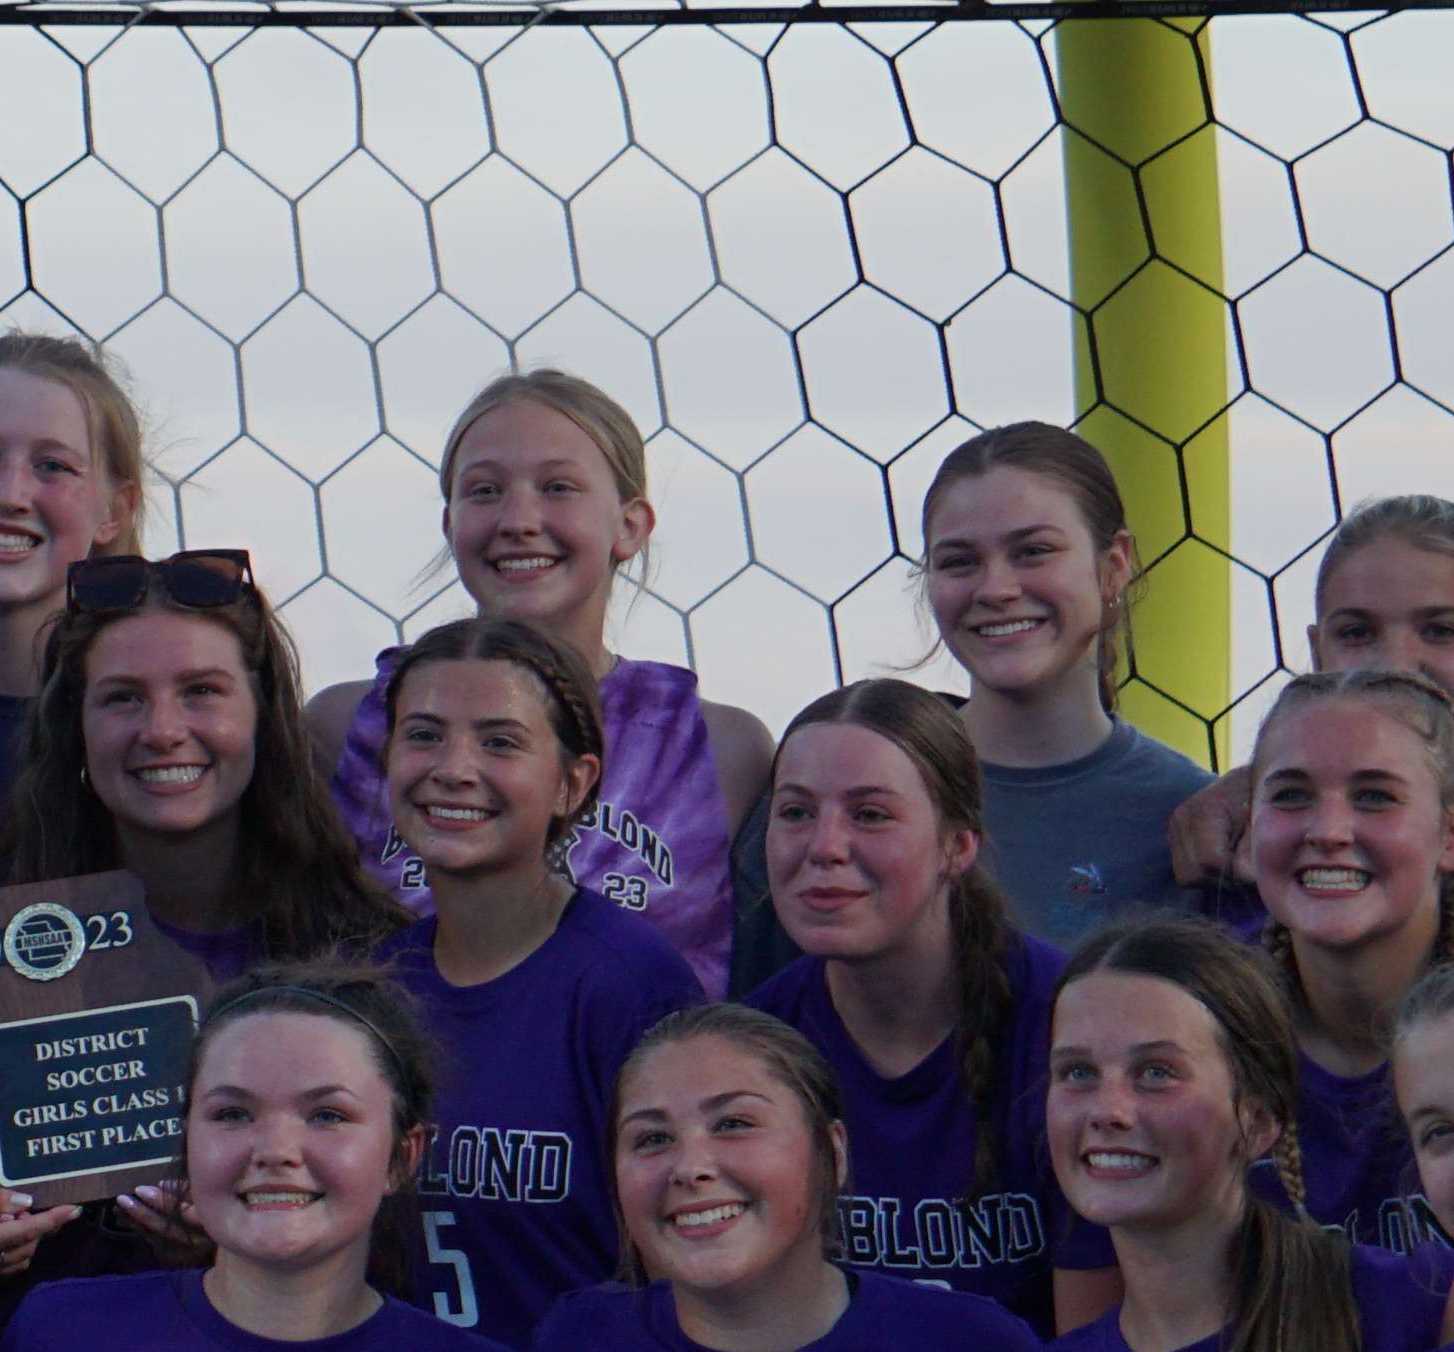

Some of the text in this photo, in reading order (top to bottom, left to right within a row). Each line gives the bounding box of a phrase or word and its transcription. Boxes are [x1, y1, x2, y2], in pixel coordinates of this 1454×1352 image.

[400, 856, 431, 890] 2
[602, 872, 648, 912] 23
[86, 911, 133, 951] 23
[35, 1027, 149, 1062] DISTRICT
[46, 1059, 147, 1091] SOCCER
[13, 1099, 88, 1127] GIRLS
[92, 1087, 170, 1116] CLASS
[27, 1117, 183, 1158] FIRST PLACE
